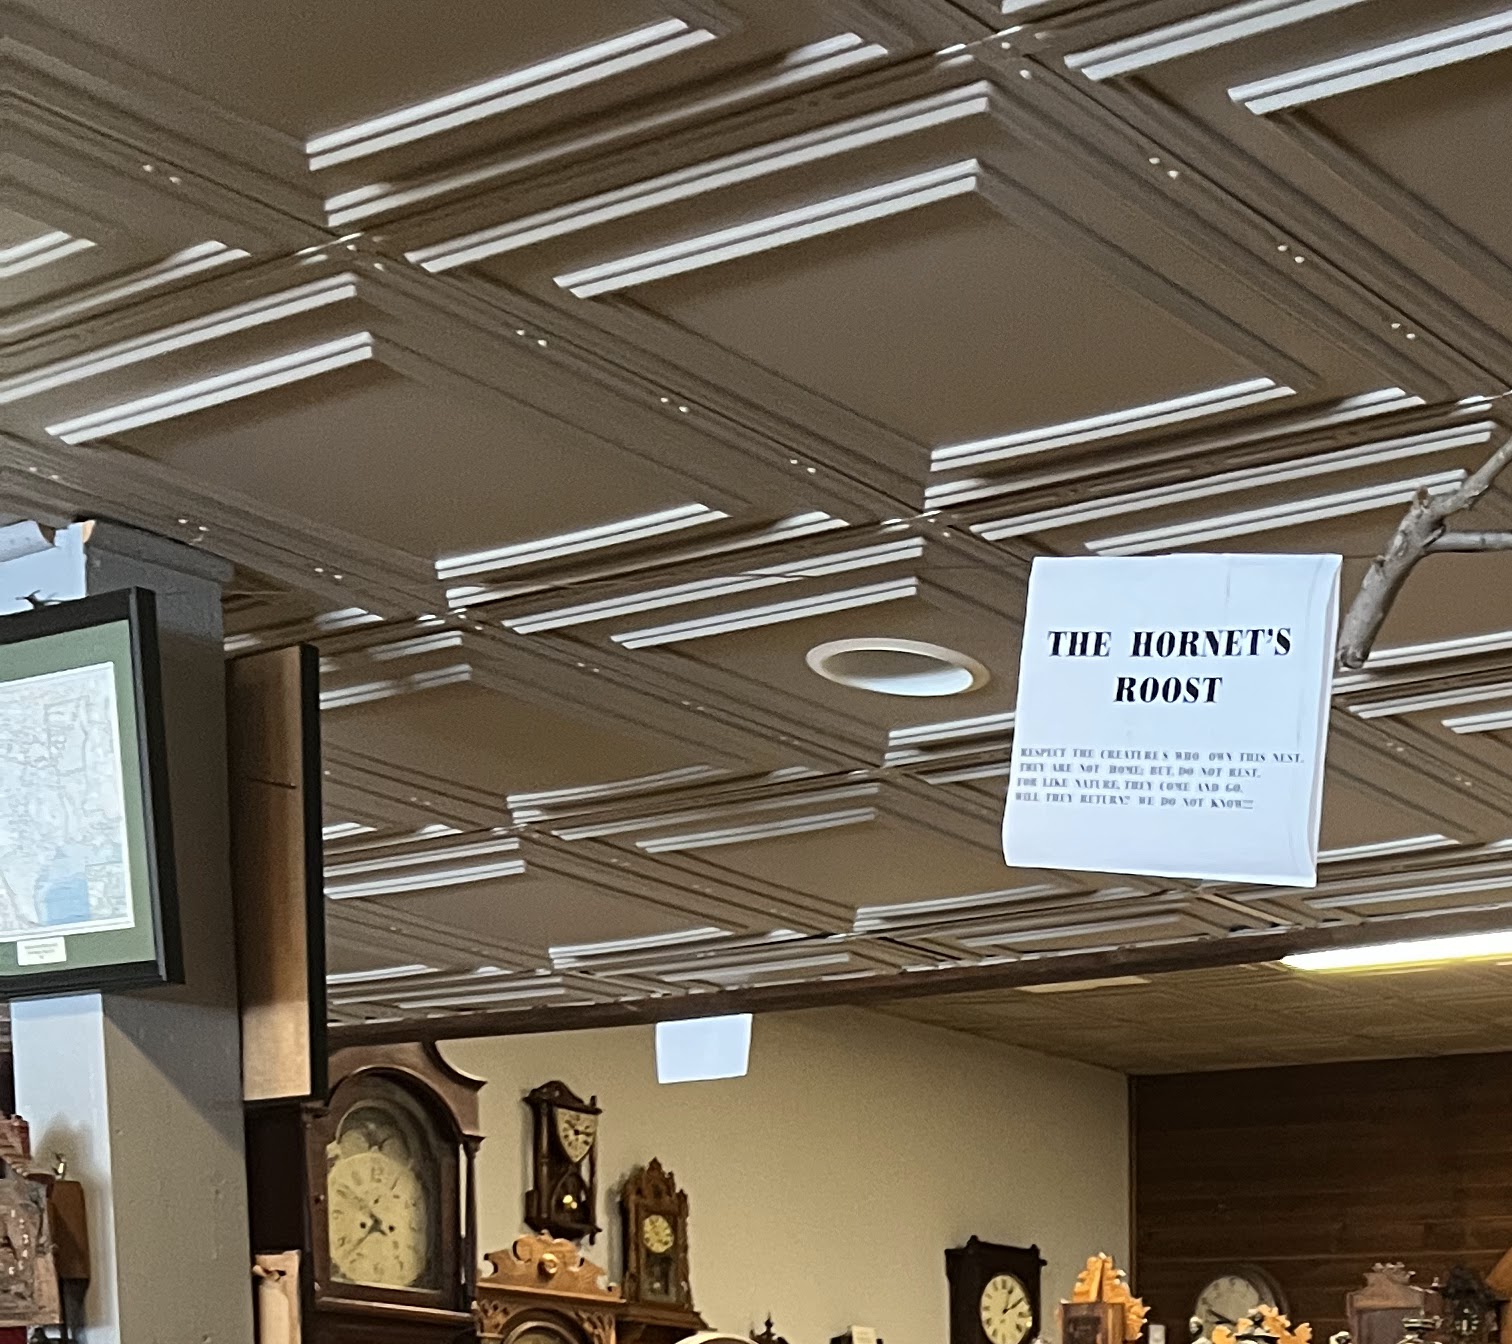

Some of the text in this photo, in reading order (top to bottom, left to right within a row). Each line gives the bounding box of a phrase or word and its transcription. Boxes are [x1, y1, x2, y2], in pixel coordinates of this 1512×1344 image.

[1047, 627, 1292, 658] THE HORNET'S
[1113, 676, 1223, 704] ROOST
[1073, 749, 1094, 758] THE
[1175, 751, 1200, 761] WHO
[1208, 752, 1232, 762] OWN
[1240, 752, 1266, 762] THIS
[1020, 762, 1044, 772] THEY
[1079, 764, 1099, 774] NOT
[1178, 767, 1194, 777] DO
[1201, 767, 1222, 778] NOT
[1017, 777, 1037, 787] FOR
[1043, 778, 1068, 788] LIKE
[1125, 780, 1153, 791] THEY
[1159, 782, 1191, 792] COME
[1198, 782, 1220, 793] AND
[1015, 792, 1039, 802] WILL
[1046, 793, 1072, 803] THEY
[1139, 796, 1154, 806] WE
[1161, 797, 1176, 807] DO
[1183, 798, 1204, 808] NOT
